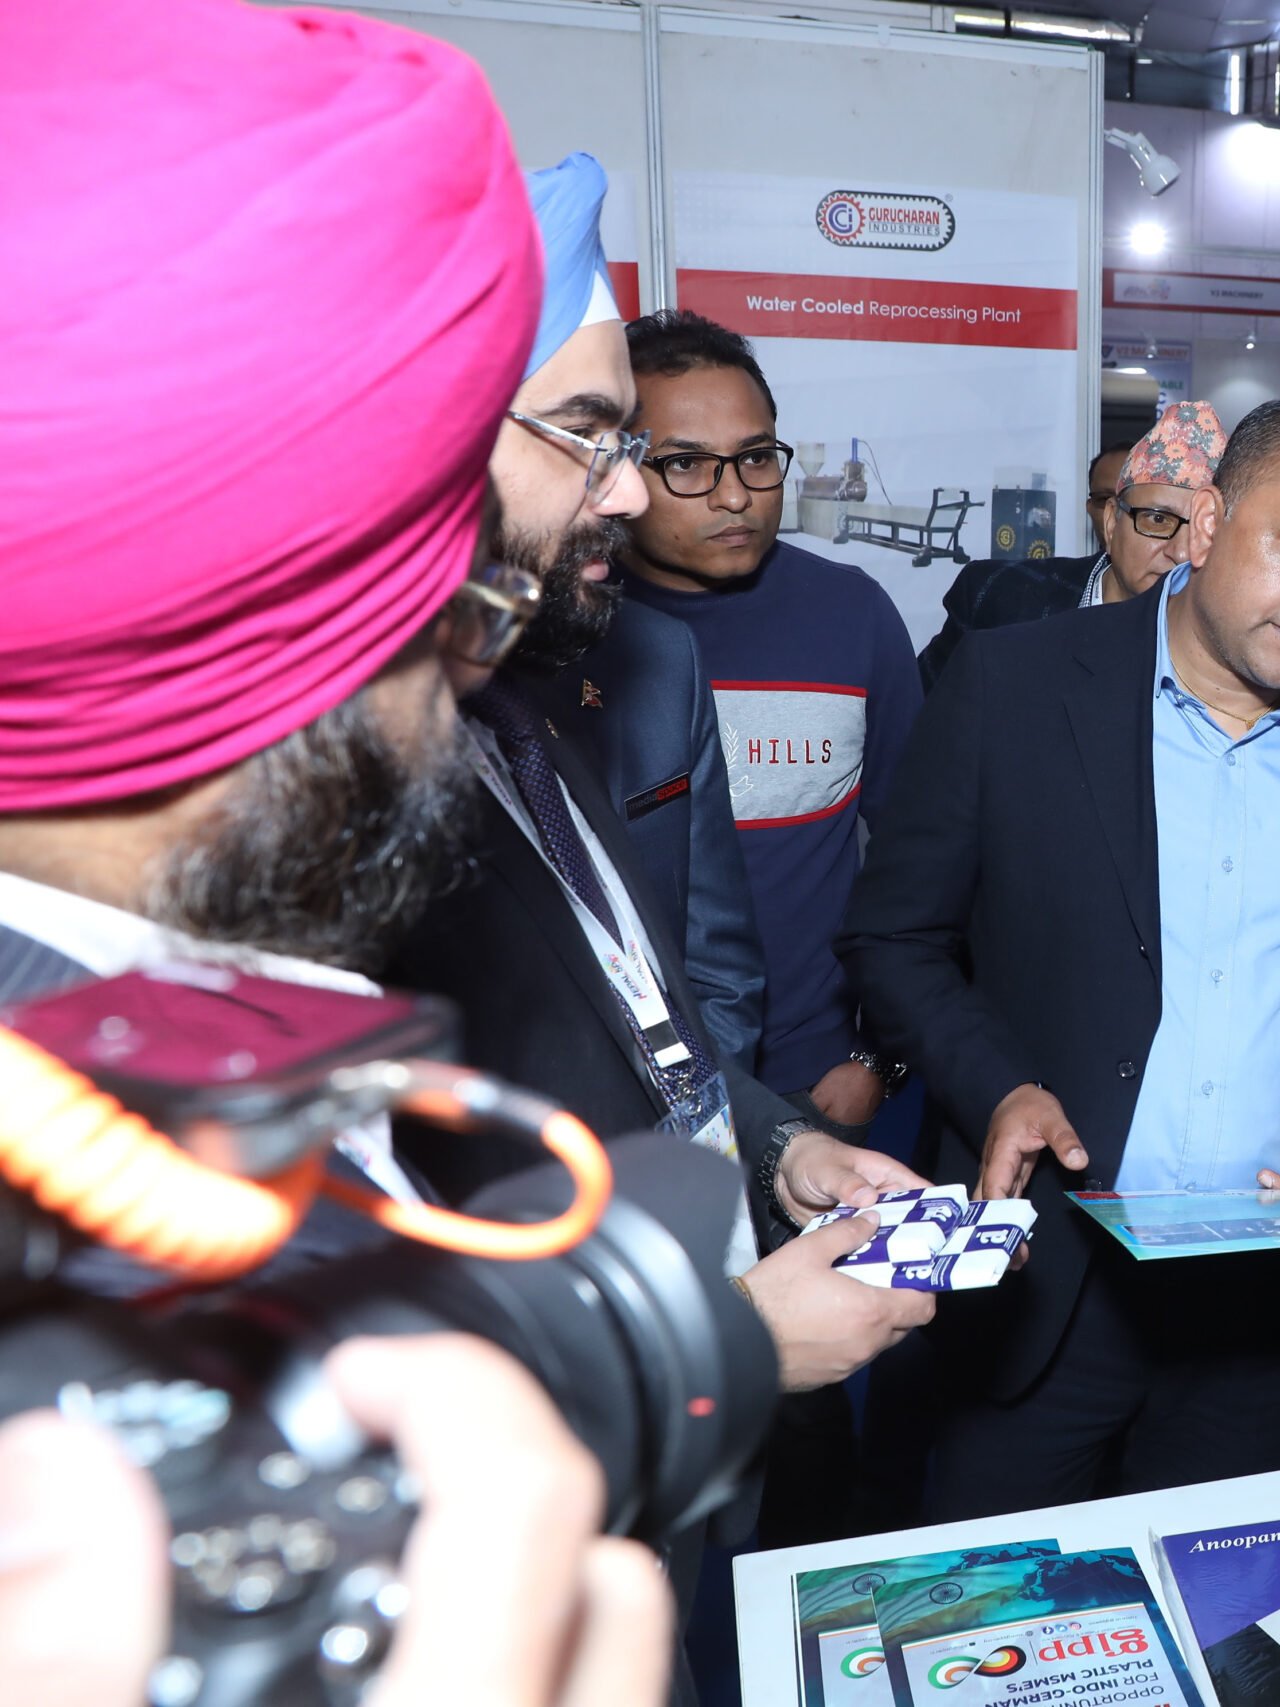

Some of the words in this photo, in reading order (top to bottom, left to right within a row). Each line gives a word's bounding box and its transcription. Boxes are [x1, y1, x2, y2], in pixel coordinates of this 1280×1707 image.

[868, 207, 940, 225] GURUCHARAN
[868, 222, 940, 236] INDUSTRIES
[746, 295, 796, 312] Water
[801, 298, 864, 315] Cooled
[869, 301, 978, 324] Reprocessing
[982, 307, 1022, 323] Plant
[747, 737, 833, 765] HILLS
[621, 972, 647, 999] NEPAL
[1038, 1628, 1149, 1662] gipp
[1080, 1658, 1154, 1677] PLASTIC
[1123, 1671, 1159, 1686] FOR
[1006, 1672, 1076, 1694] MSME'S
[1051, 1685, 1165, 1707] OPPORTUN
